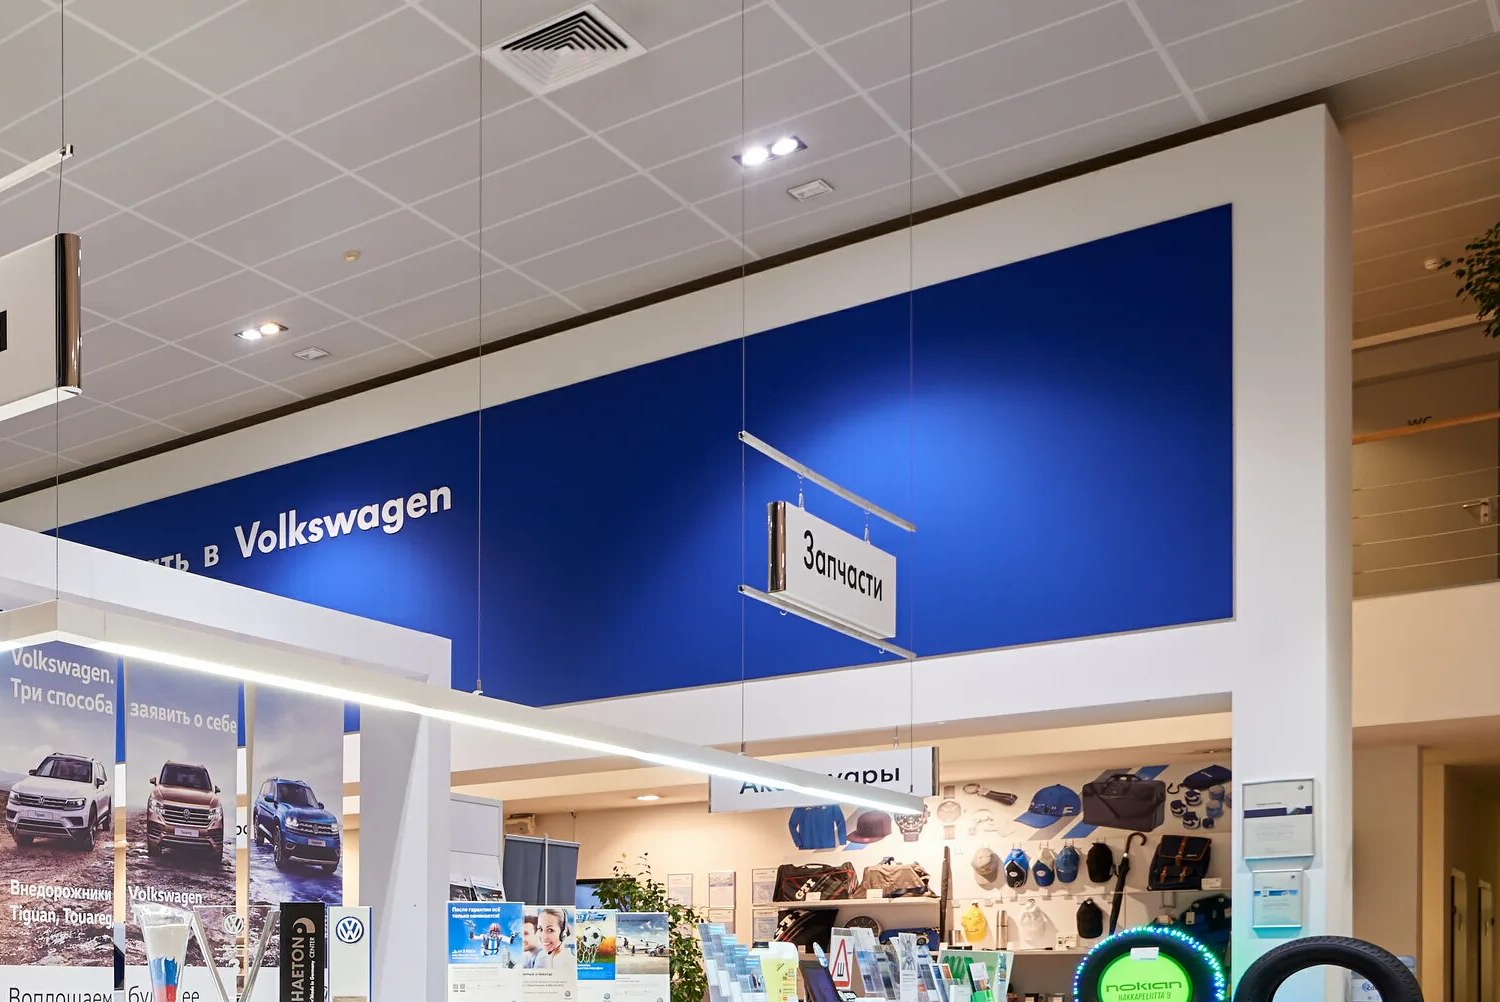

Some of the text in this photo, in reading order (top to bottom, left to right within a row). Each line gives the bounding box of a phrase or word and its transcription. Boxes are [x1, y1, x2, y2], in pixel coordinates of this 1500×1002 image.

[204, 545, 220, 568] в
[235, 484, 452, 558] Volkswagen
[803, 529, 883, 602] Запчасти
[11, 648, 114, 685] Volkswagen.
[10, 678, 114, 716] Три способа
[130, 702, 237, 734] заявить о себе
[10, 879, 112, 902] Внедорожники
[128, 886, 203, 906] Volkswagen
[10, 905, 60, 928] Tiguan,
[1106, 981, 1182, 992] nokian
